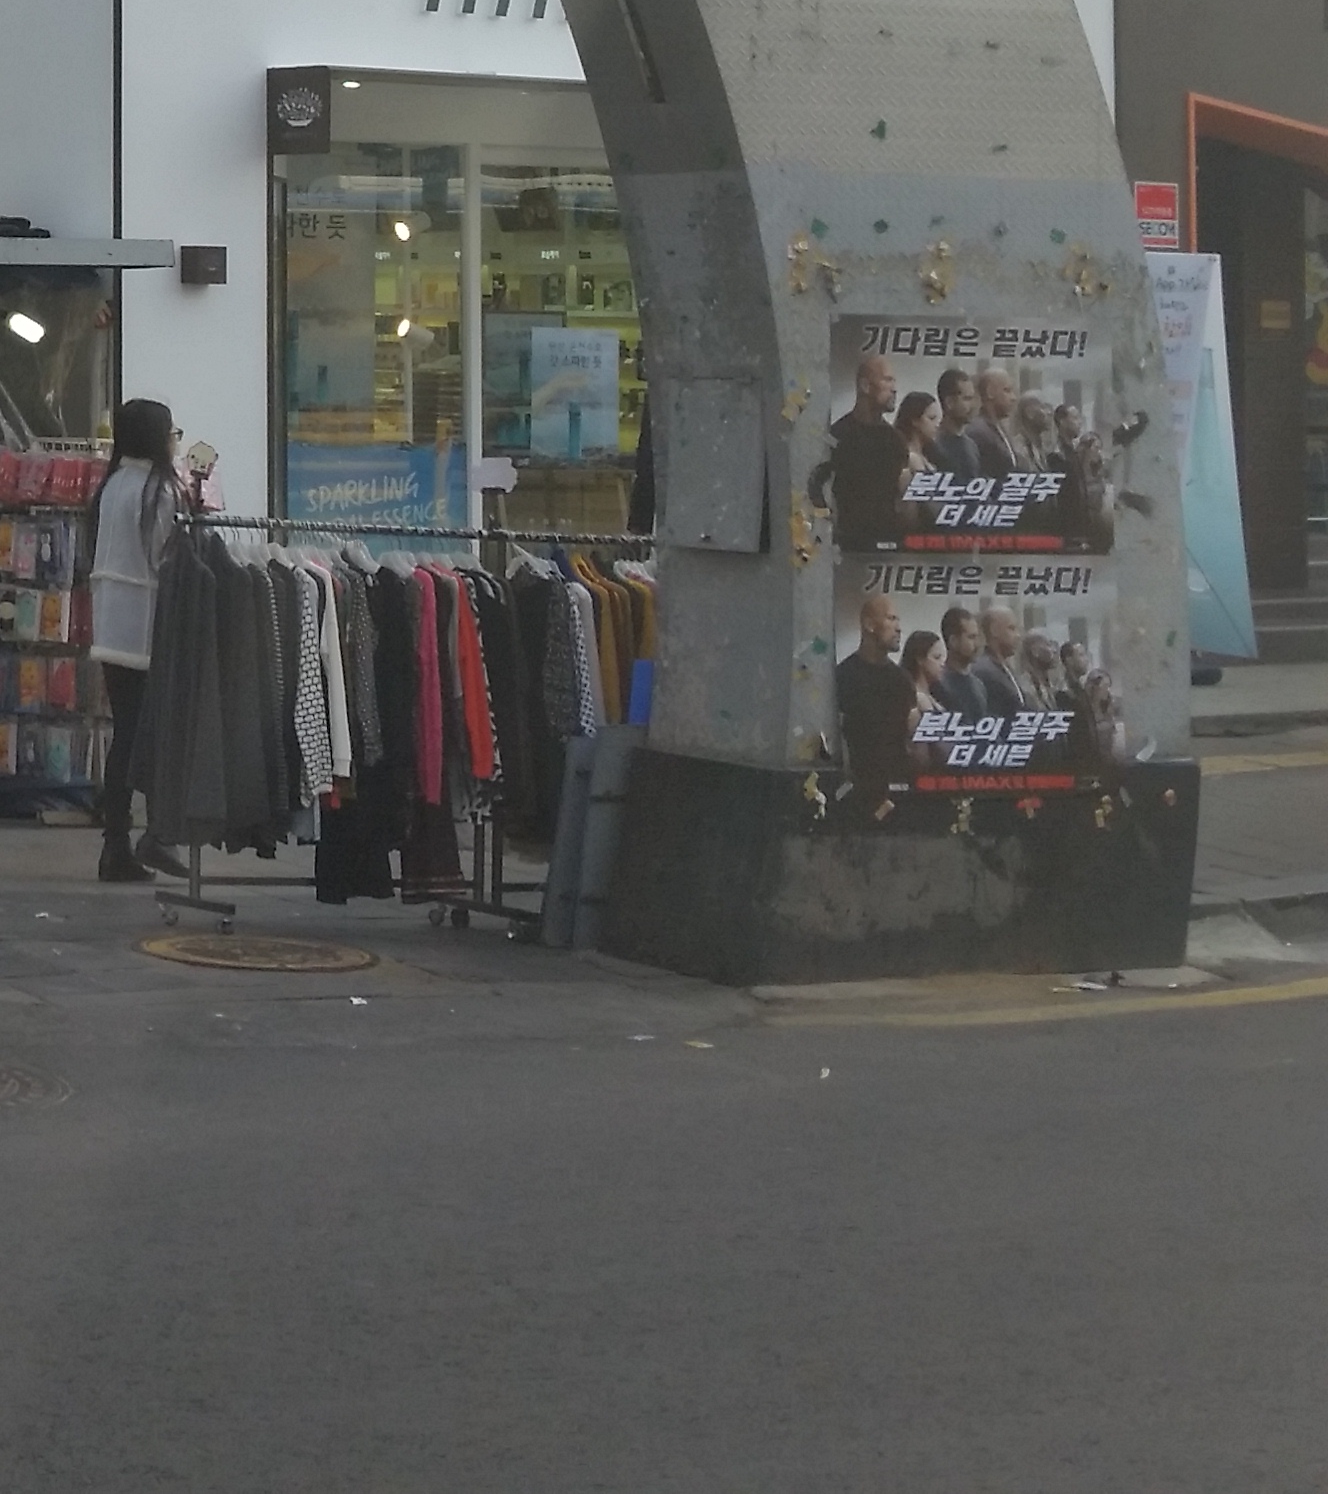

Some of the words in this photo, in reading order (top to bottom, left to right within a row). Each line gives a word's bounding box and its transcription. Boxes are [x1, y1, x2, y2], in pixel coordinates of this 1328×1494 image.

[1139, 222, 1175, 236] SEOM
[862, 326, 980, 357] 기다림은
[992, 328, 1088, 358] 끝났다!
[305, 471, 419, 513] SPARKLING
[902, 472, 995, 502] 분노의
[998, 472, 1066, 502] 질주
[936, 504, 966, 527] 더
[967, 504, 1023, 527] 세븐
[865, 565, 983, 595] 기다림은
[995, 566, 1092, 596] 끝났다!
[912, 711, 1004, 742] 분노의
[1007, 711, 1075, 741] 질주
[947, 744, 977, 767] 더
[978, 744, 1033, 767] 세븐
